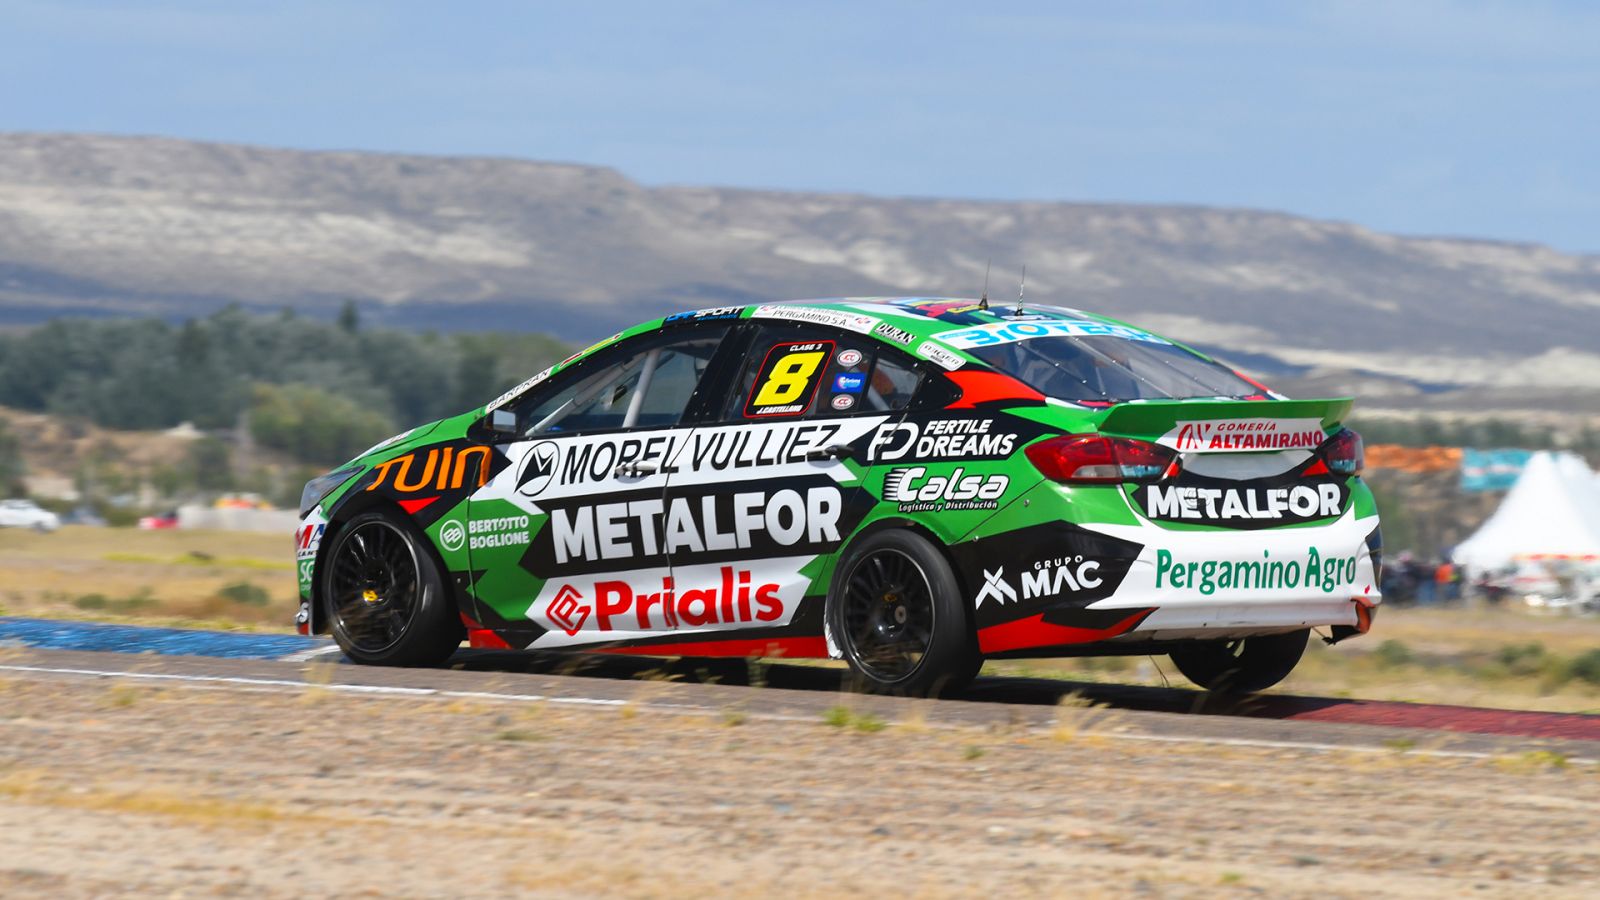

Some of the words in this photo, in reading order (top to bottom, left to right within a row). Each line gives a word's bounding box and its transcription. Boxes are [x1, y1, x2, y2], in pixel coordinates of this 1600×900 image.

[773, 310, 830, 323] PERGAMINO
[875, 322, 917, 344] DURAN
[753, 352, 826, 406] 8
[923, 419, 993, 435] FERTILE
[1209, 430, 1324, 449] ALTAMIRANO
[560, 435, 679, 485] MOREL
[691, 424, 842, 472] VULLIEZ
[916, 433, 1018, 458] DREAMS
[896, 466, 1010, 502] Calsa
[936, 503, 943, 512] y
[945, 501, 998, 510] Distribución
[1147, 483, 1342, 519] METALFOR
[468, 515, 529, 534] BERTOTTO
[551, 486, 843, 564] METALFOR
[469, 531, 530, 549] BOGLIONE
[1034, 555, 1083, 570] GRUPO
[1155, 549, 1300, 595] Pergamino
[1305, 546, 1357, 593] Agro
[1021, 560, 1104, 599] MAC
[594, 566, 784, 632] Prialis
